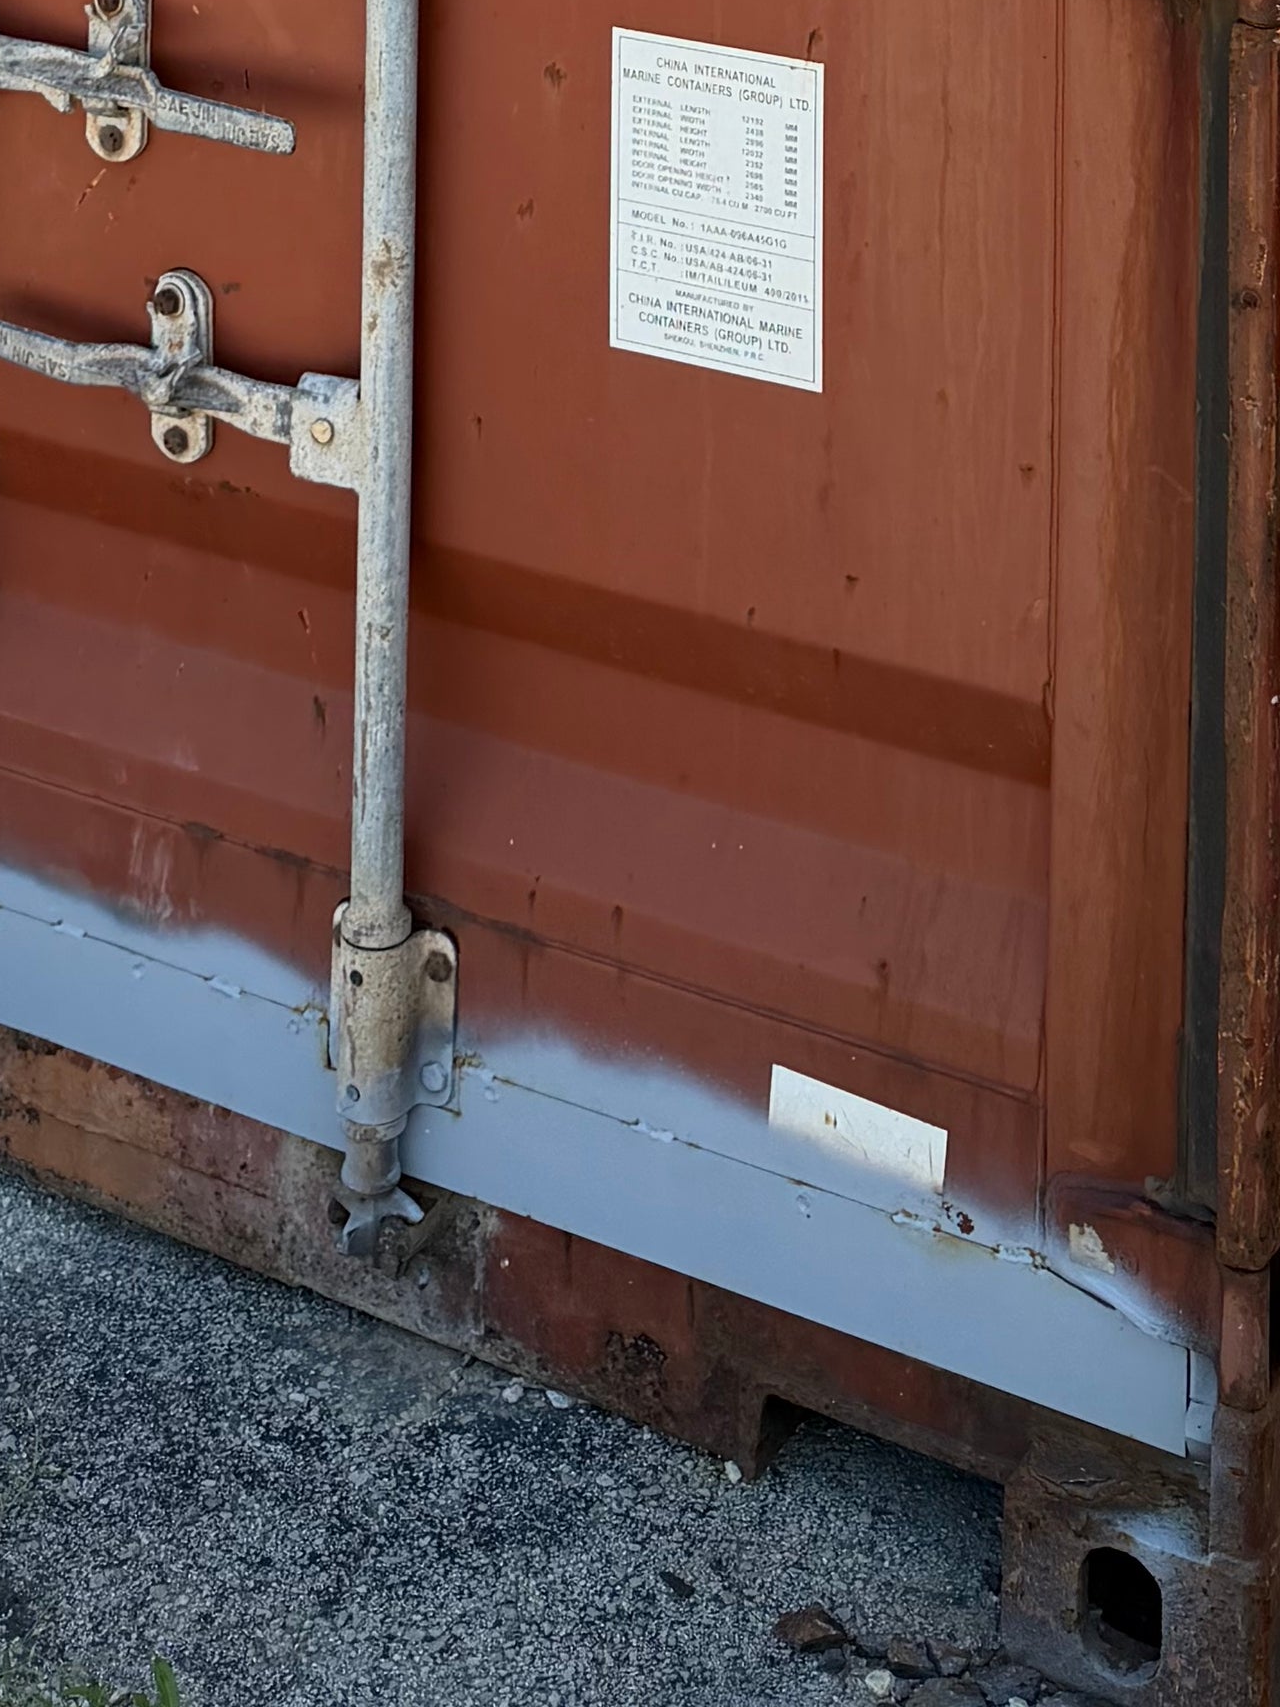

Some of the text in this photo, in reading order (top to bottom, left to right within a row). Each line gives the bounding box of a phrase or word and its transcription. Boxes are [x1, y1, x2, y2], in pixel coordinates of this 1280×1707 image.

[622, 66, 812, 112] MARINE CONTAINERS (GROUP) LTD.
[655, 55, 776, 89] CHINA INTERNATIONAL
[630, 208, 666, 225] MODEL
[627, 291, 803, 340] CHINA INTERNATIONAL MARINE
[638, 310, 792, 355] CONTAINERS (GROUP) LTD.
